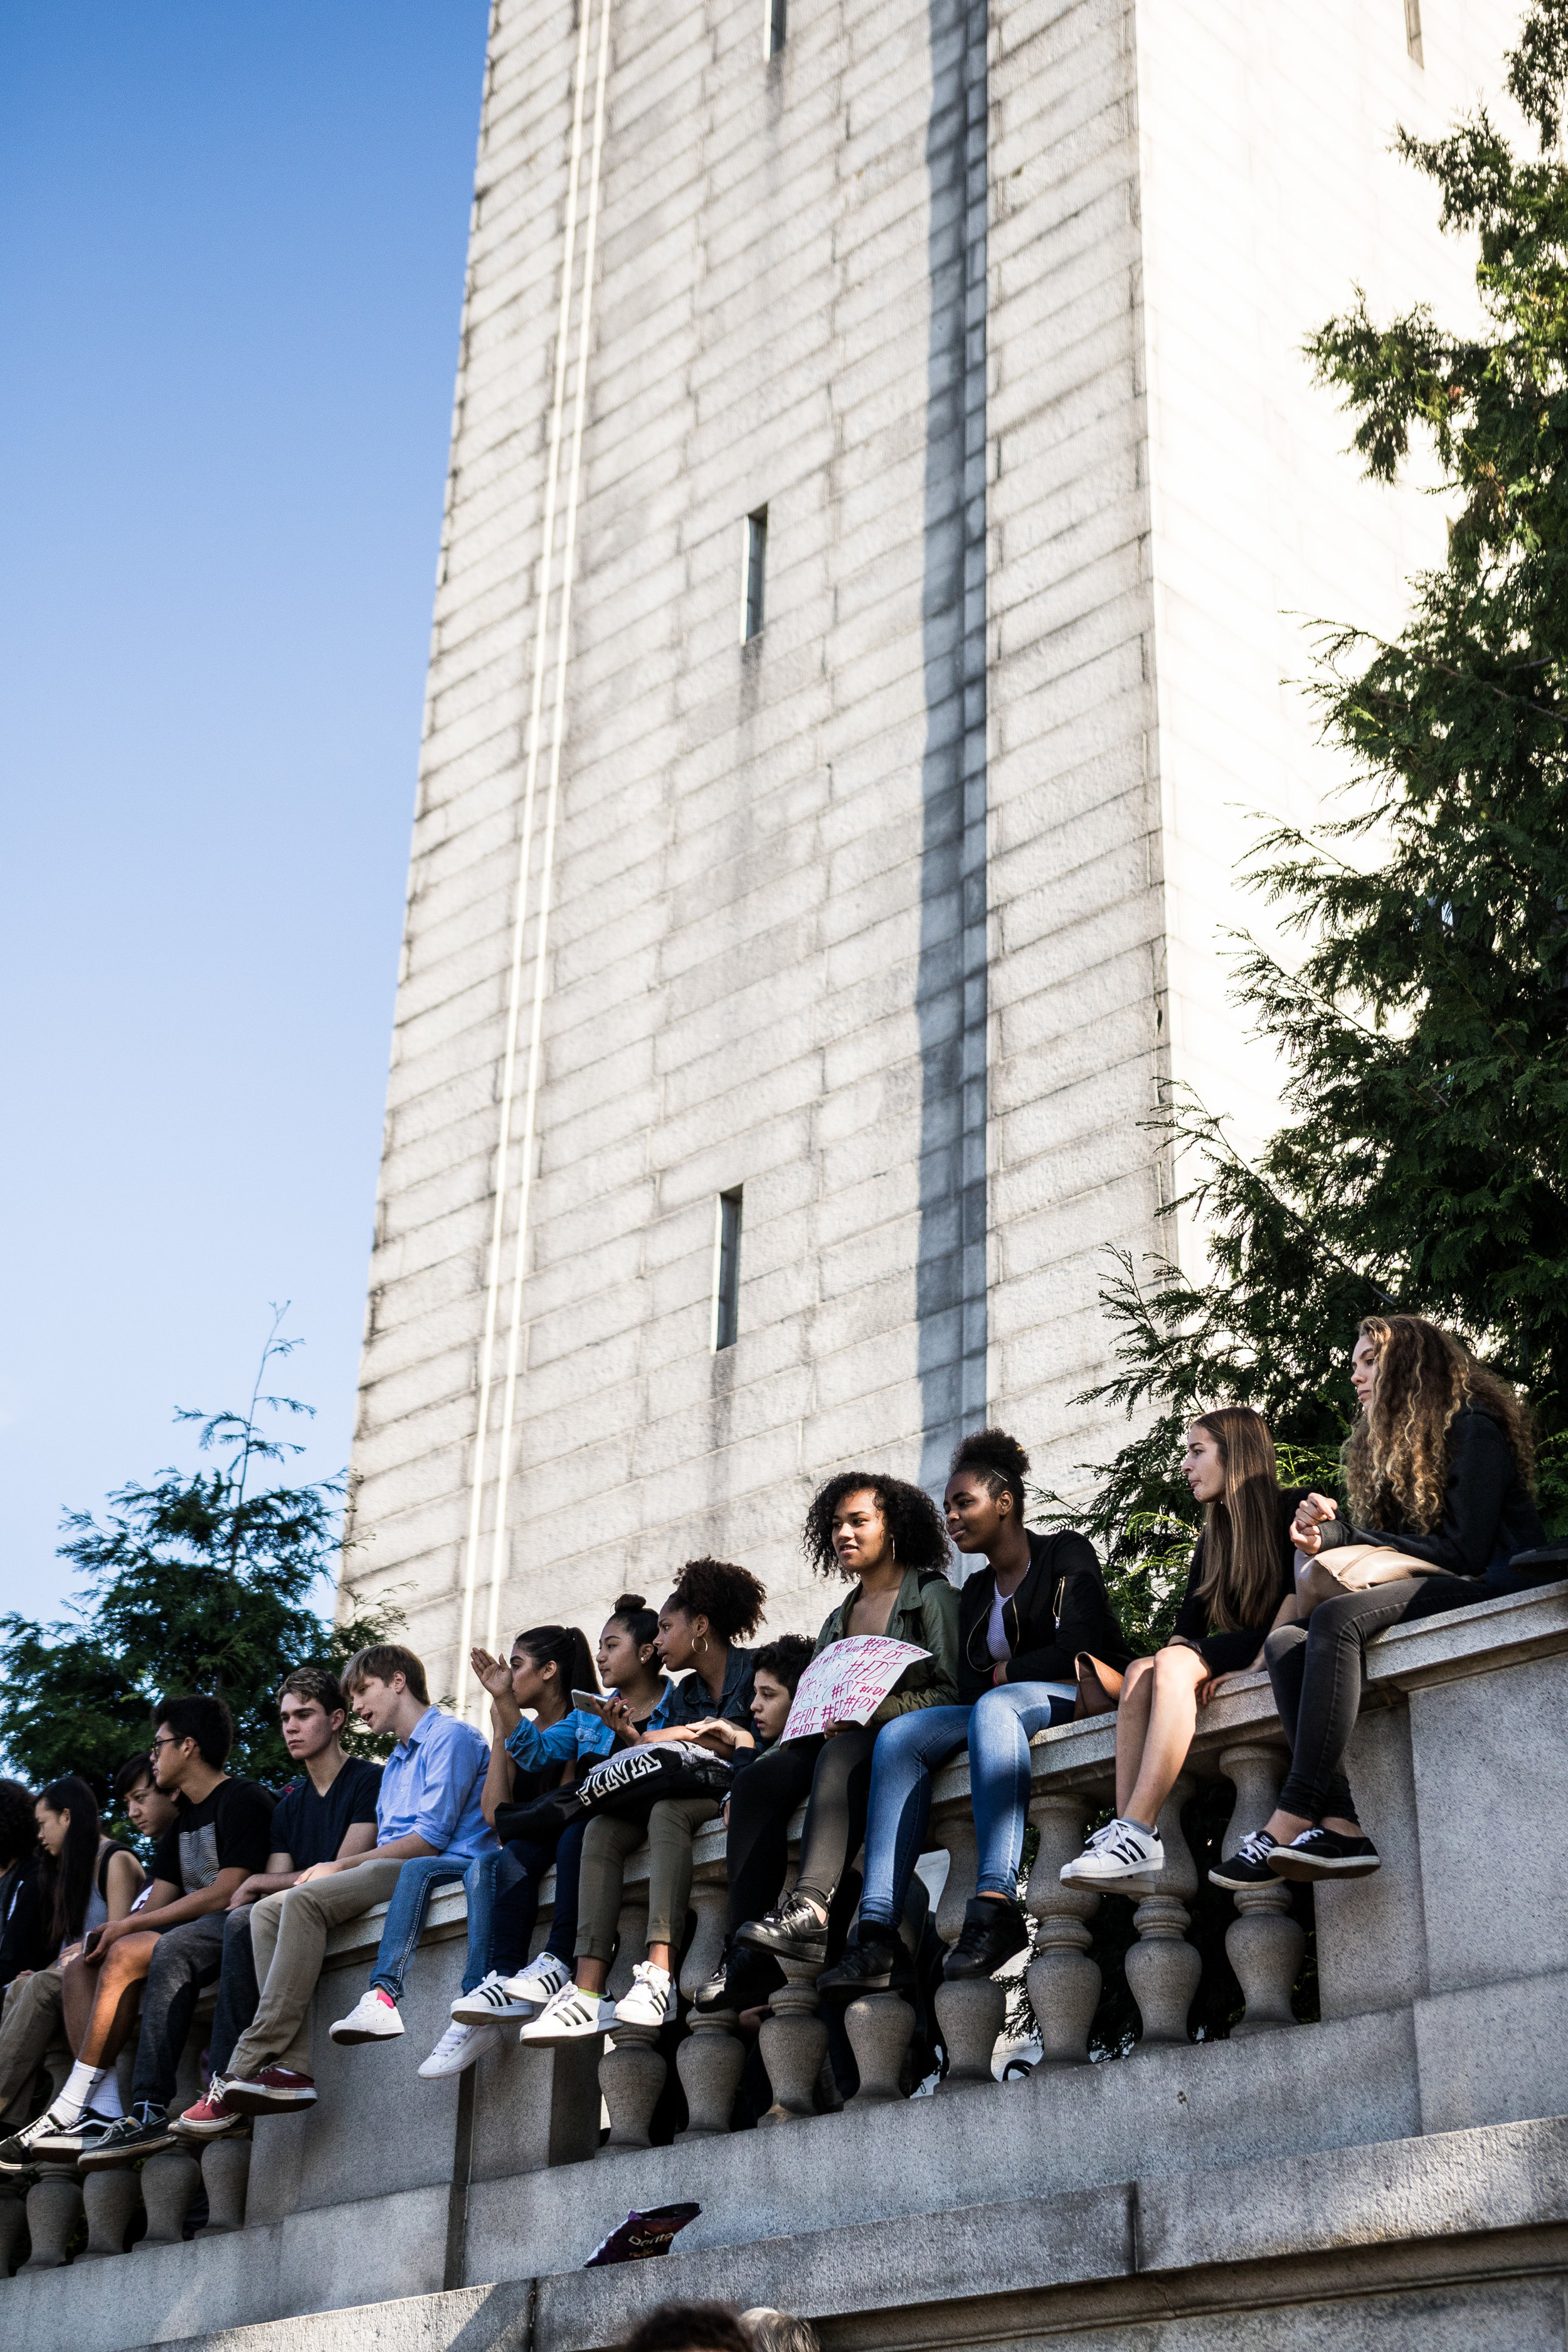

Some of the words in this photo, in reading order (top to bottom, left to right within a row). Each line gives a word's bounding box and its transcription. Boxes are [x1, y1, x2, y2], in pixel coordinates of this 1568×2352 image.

[862, 1638, 895, 1648] #FDT
[896, 1643, 928, 1656] #FDT
[859, 1648, 911, 1660] #FDT
[842, 1660, 903, 1685] #FDT
[859, 1685, 887, 1697] #FDT
[844, 1695, 878, 1712] #FDT
[790, 1707, 818, 1727] #FDT
[790, 1723, 819, 1738] #FDT
